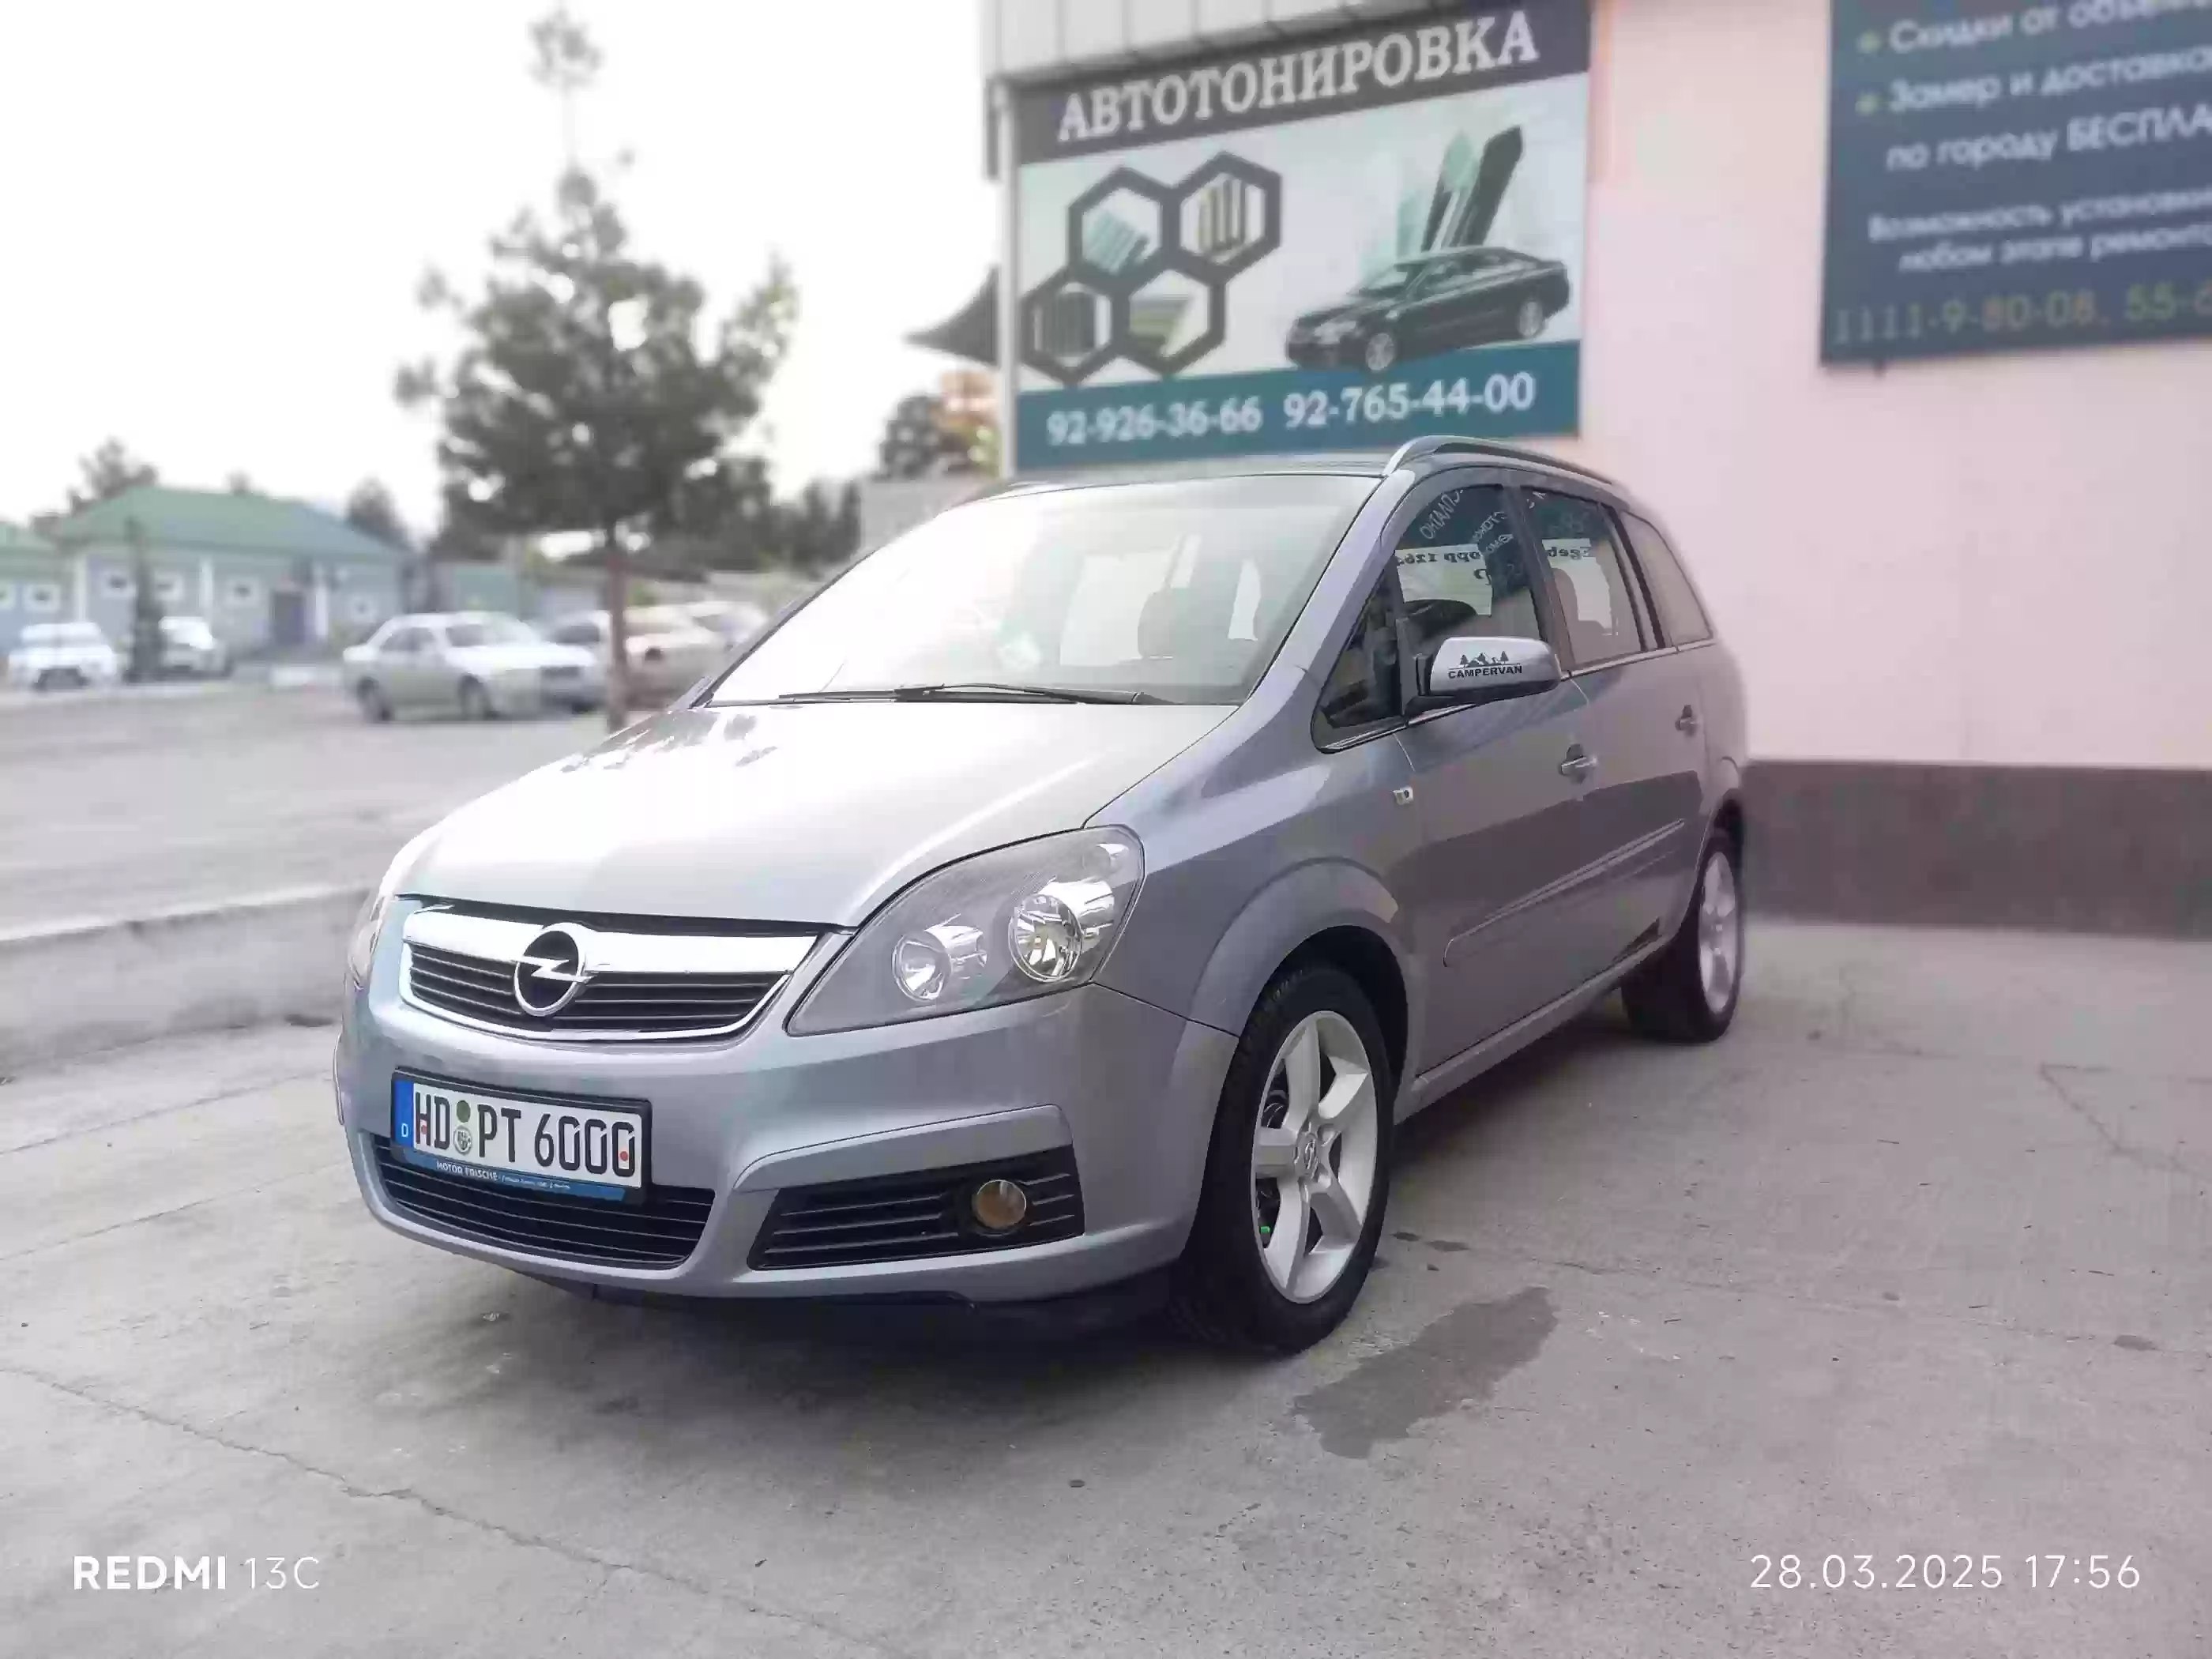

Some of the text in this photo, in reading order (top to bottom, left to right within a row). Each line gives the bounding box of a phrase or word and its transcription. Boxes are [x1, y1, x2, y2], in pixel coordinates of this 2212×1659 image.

[1057, 9, 1539, 142] АВТОТОНИРОВКА
[1886, 142, 1932, 172] по
[1936, 130, 2059, 171] городу
[1046, 371, 1537, 447] 92-926-36-66 92-765-44-00
[1447, 665, 1523, 679] CAMPERVAN
[401, 1123, 409, 1138] D
[415, 1092, 635, 1178] HD PT 6000
